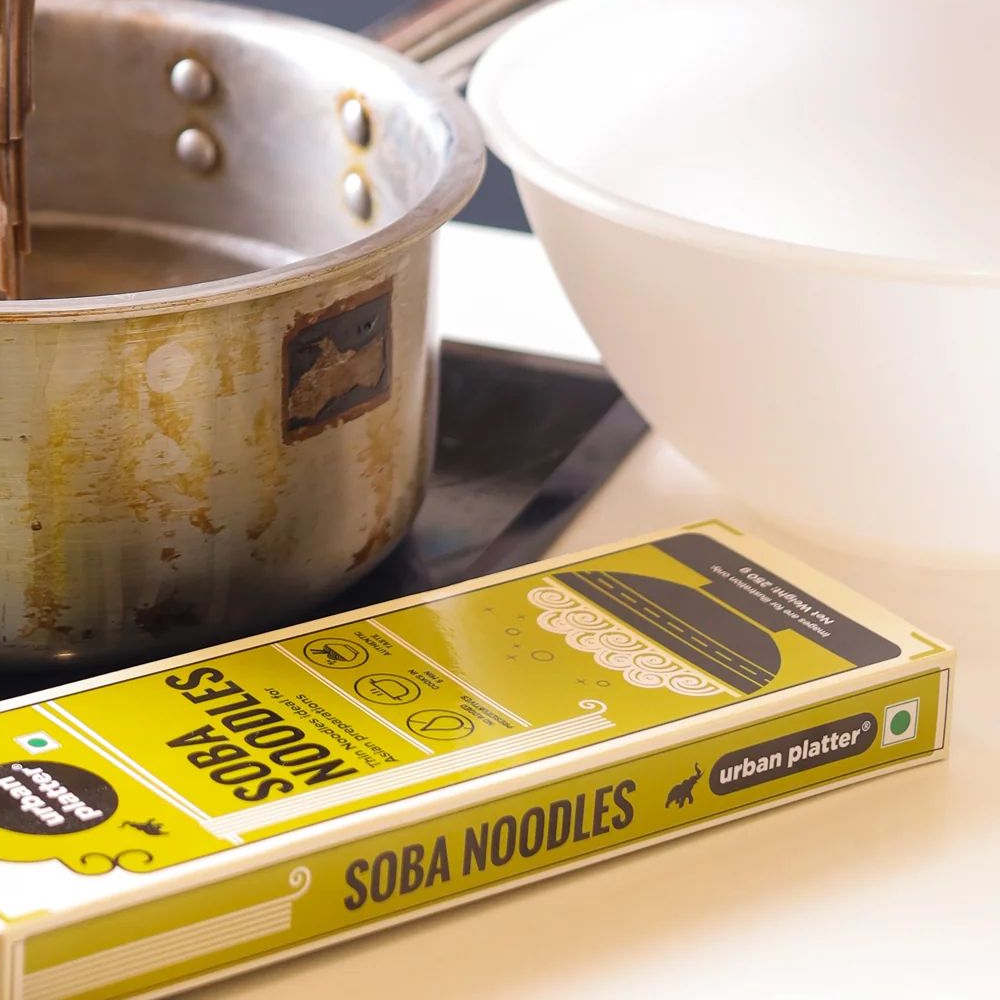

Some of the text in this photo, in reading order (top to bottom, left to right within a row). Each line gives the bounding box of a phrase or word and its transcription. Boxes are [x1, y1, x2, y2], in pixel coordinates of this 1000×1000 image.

[810, 610, 835, 625] Net
[164, 724, 295, 802] SOBA
[165, 667, 359, 786] NOODLES
[264, 687, 381, 768] Thin Noodles ideal for
[295, 693, 399, 763] Asian preparations
[718, 752, 783, 785] urban
[343, 778, 637, 912] SOBA NOODLES
